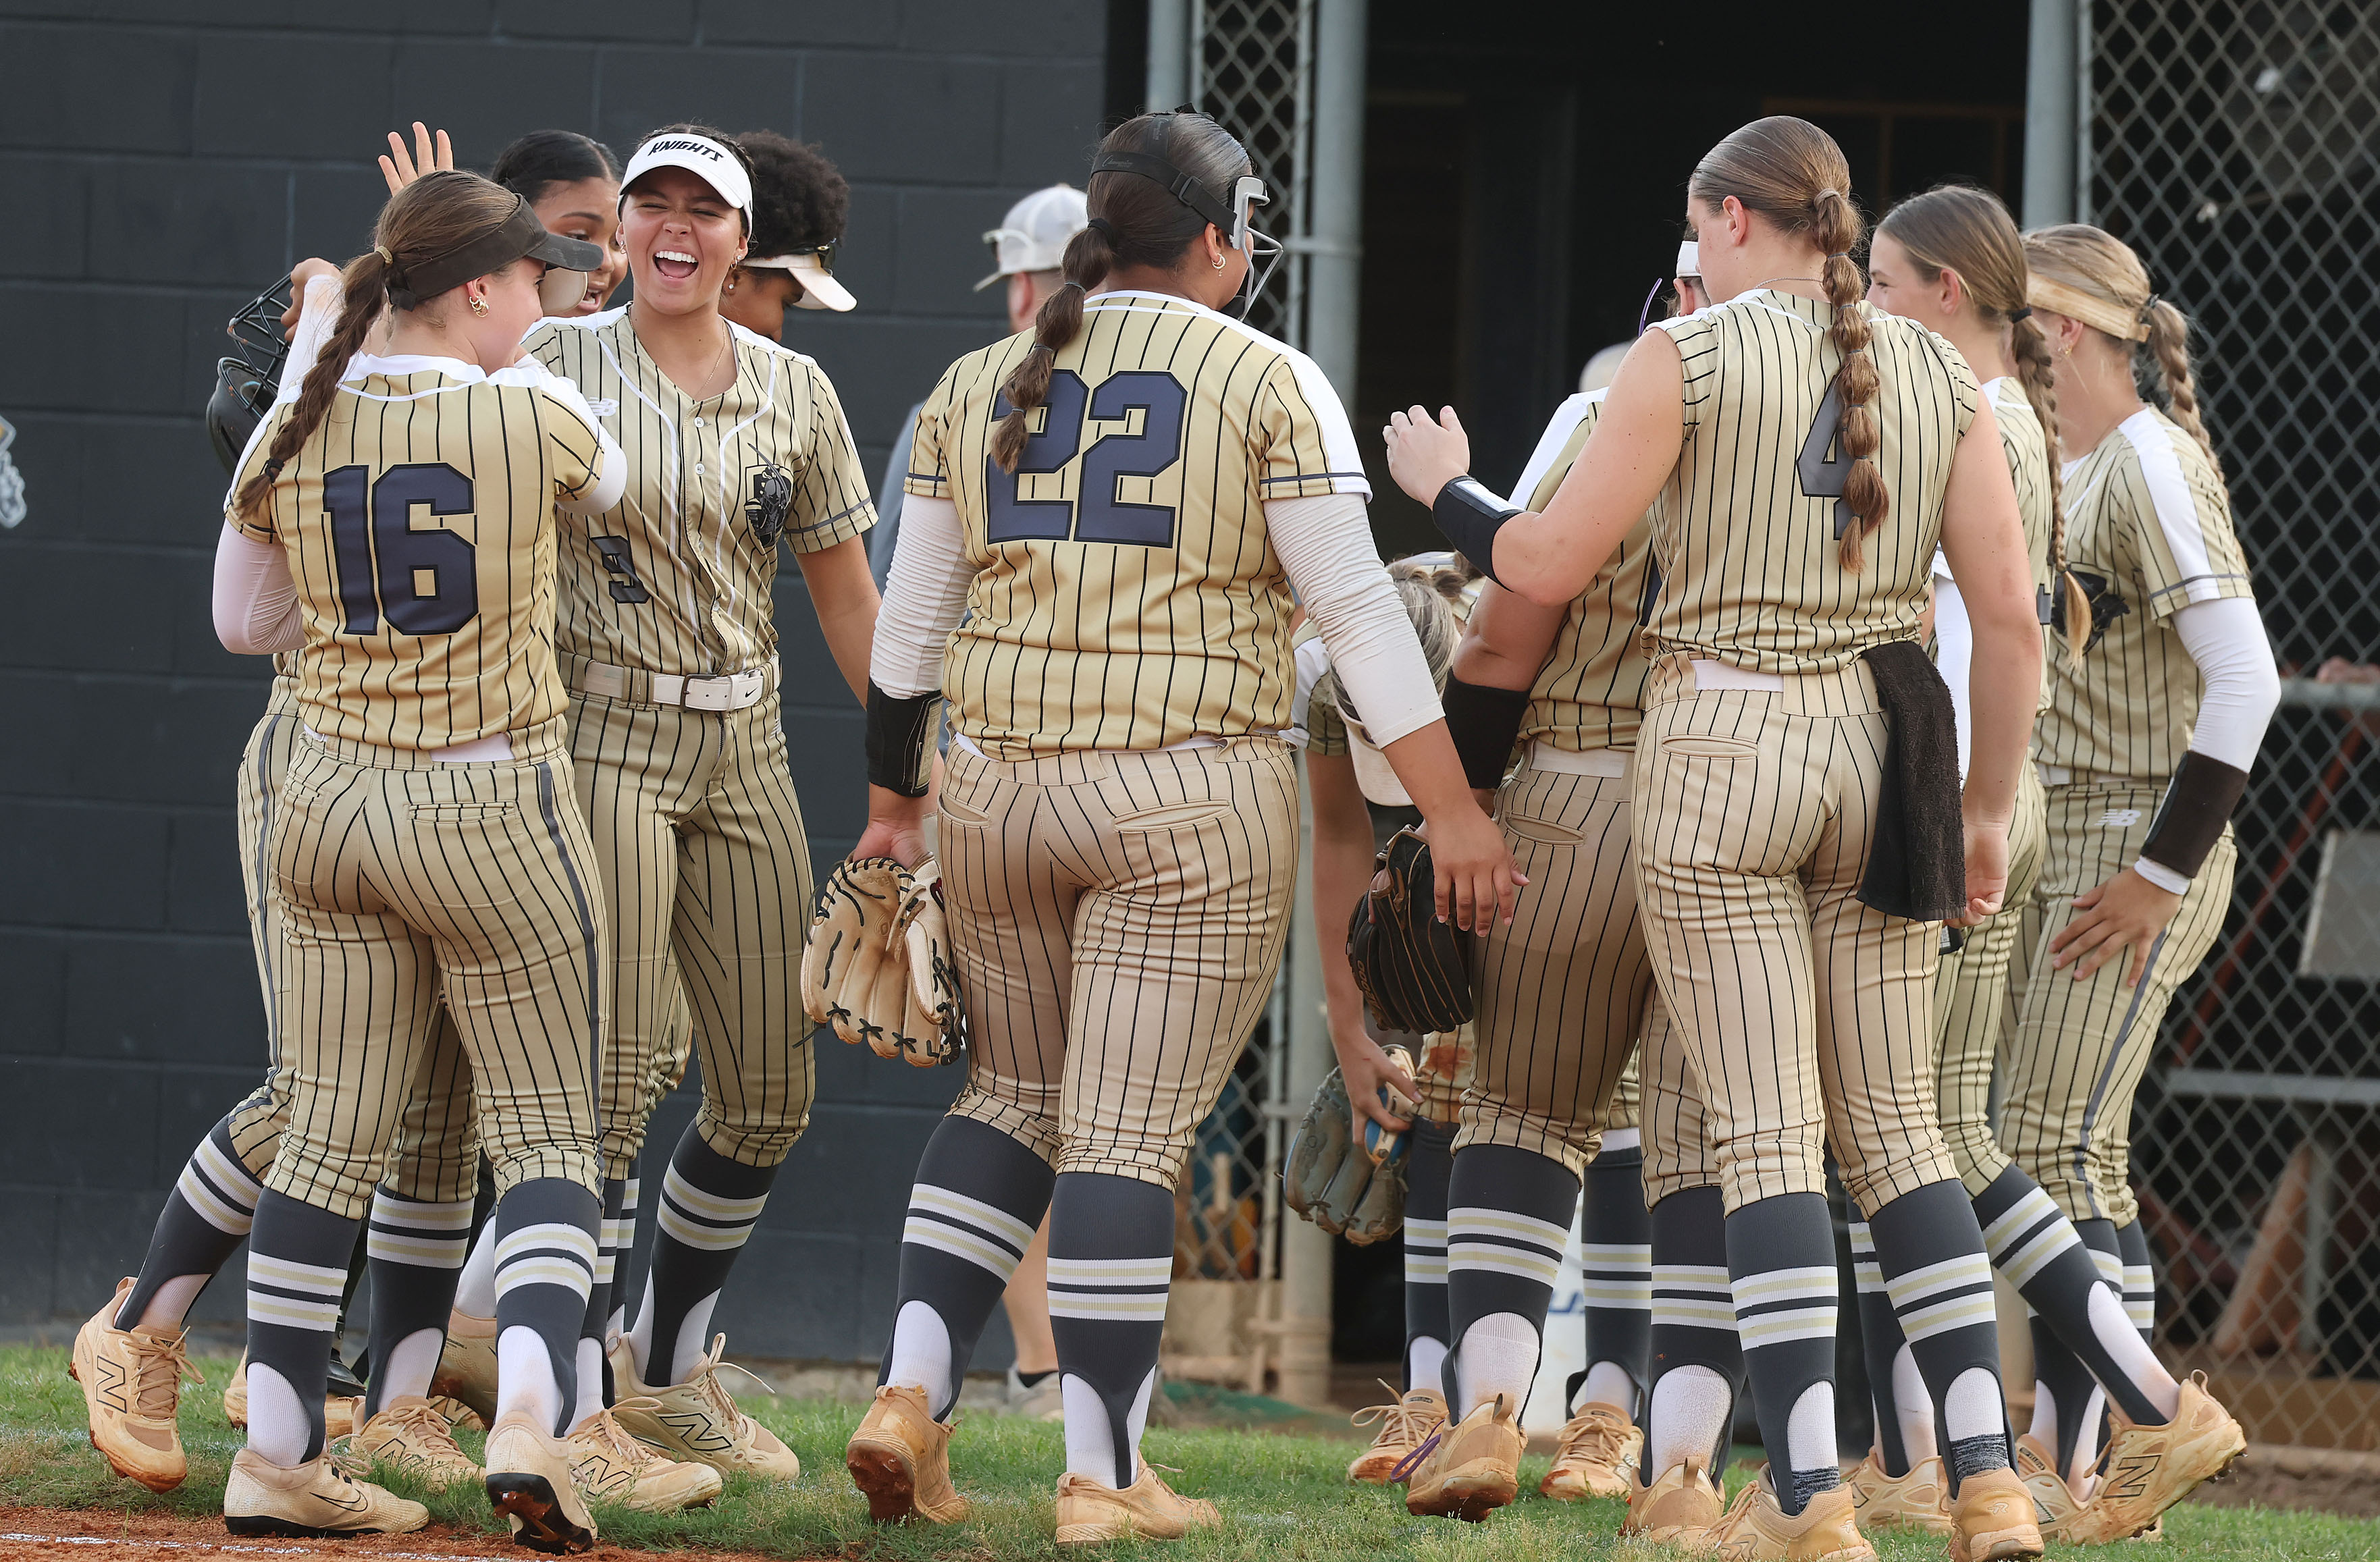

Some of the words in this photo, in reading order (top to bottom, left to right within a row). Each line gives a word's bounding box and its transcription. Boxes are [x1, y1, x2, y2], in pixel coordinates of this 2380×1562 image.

[647, 140, 724, 162] KNIGHTS
[986, 369, 1188, 548] 22
[1796, 375, 1873, 540] 4
[323, 462, 479, 635] 16
